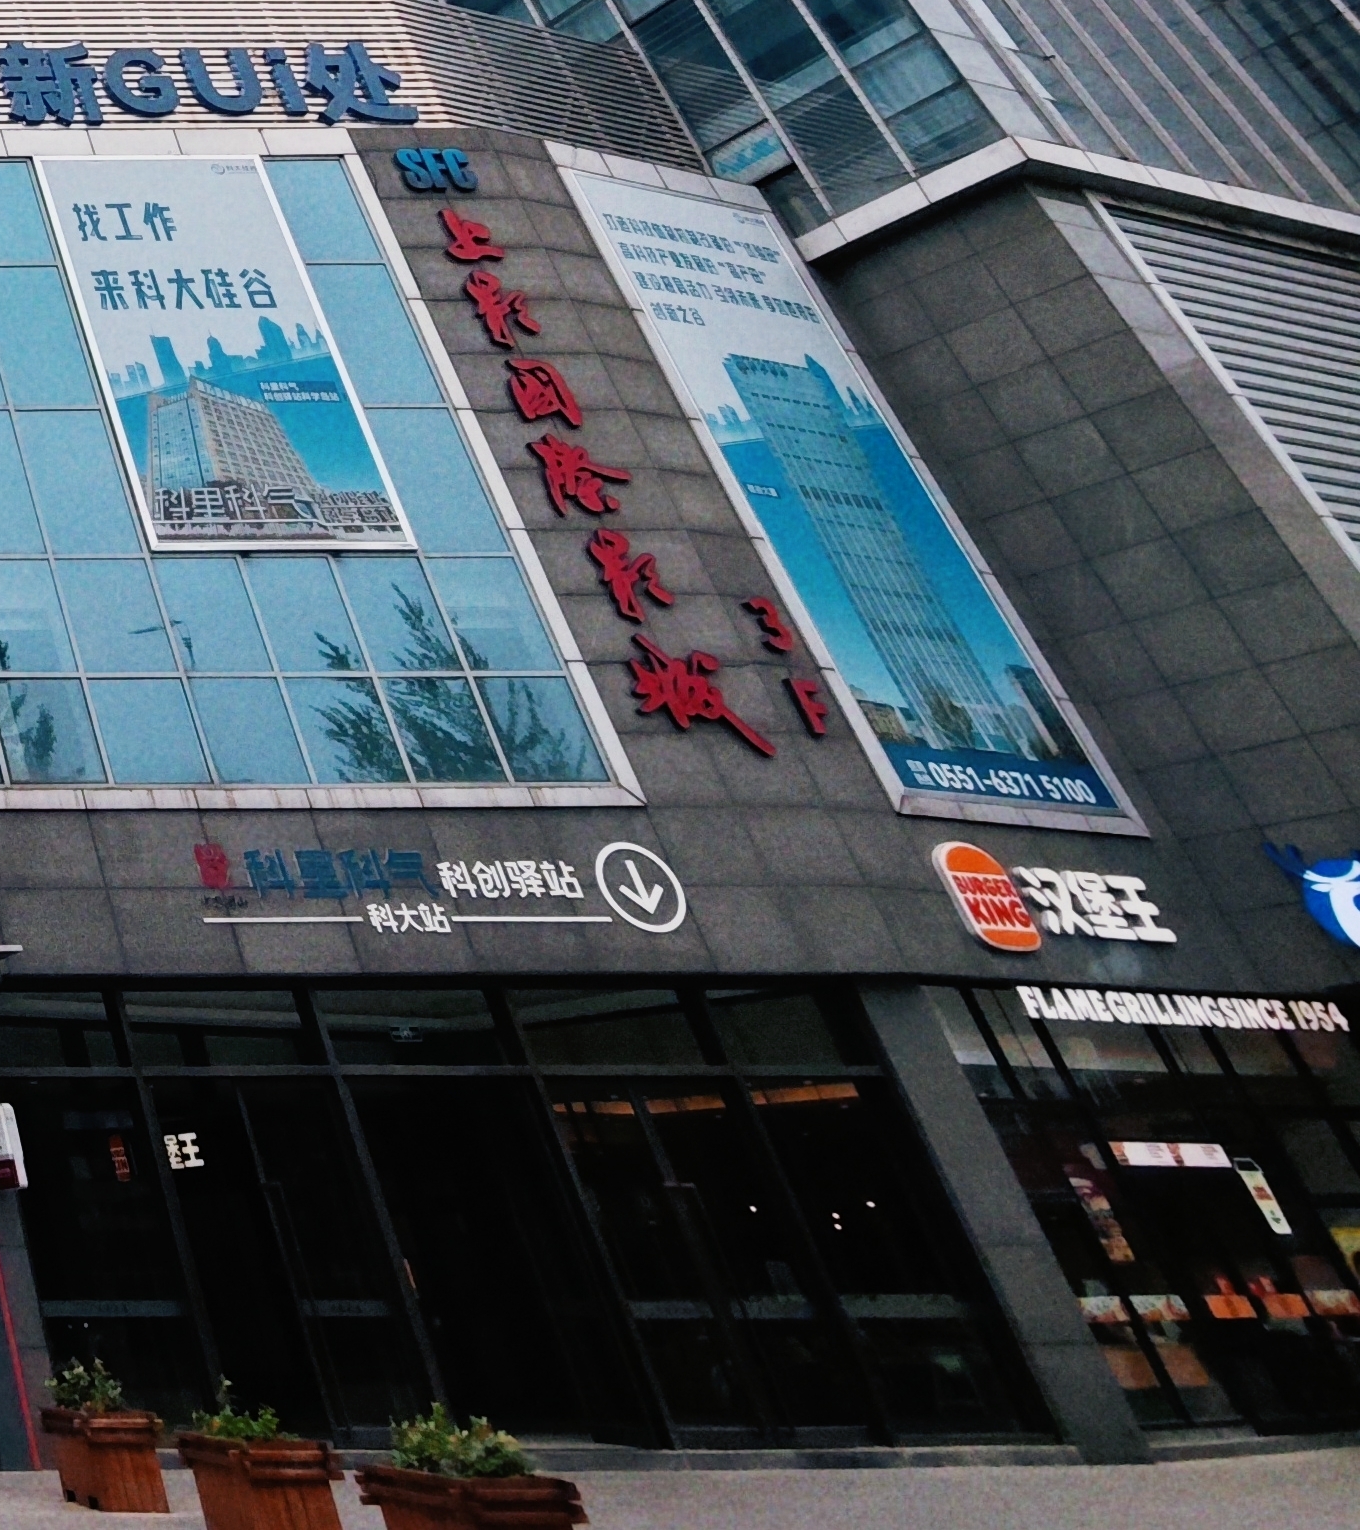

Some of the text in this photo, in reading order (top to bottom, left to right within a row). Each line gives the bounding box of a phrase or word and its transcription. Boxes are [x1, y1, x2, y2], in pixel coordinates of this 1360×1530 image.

[395, 147, 479, 192] SFC
[72, 201, 178, 244] 找工作
[93, 269, 278, 313] 来科大硅谷
[154, 483, 314, 521] 科里科气
[928, 761, 1043, 798] 0551-6371
[1038, 774, 1097, 804] 5100
[435, 860, 585, 898] 科创驿站
[951, 874, 1017, 899] BURGER
[366, 903, 452, 933] 科大站
[963, 897, 1030, 928] KING
[1012, 866, 1178, 943] 汉堡王
[1288, 999, 1350, 1032] 1954
